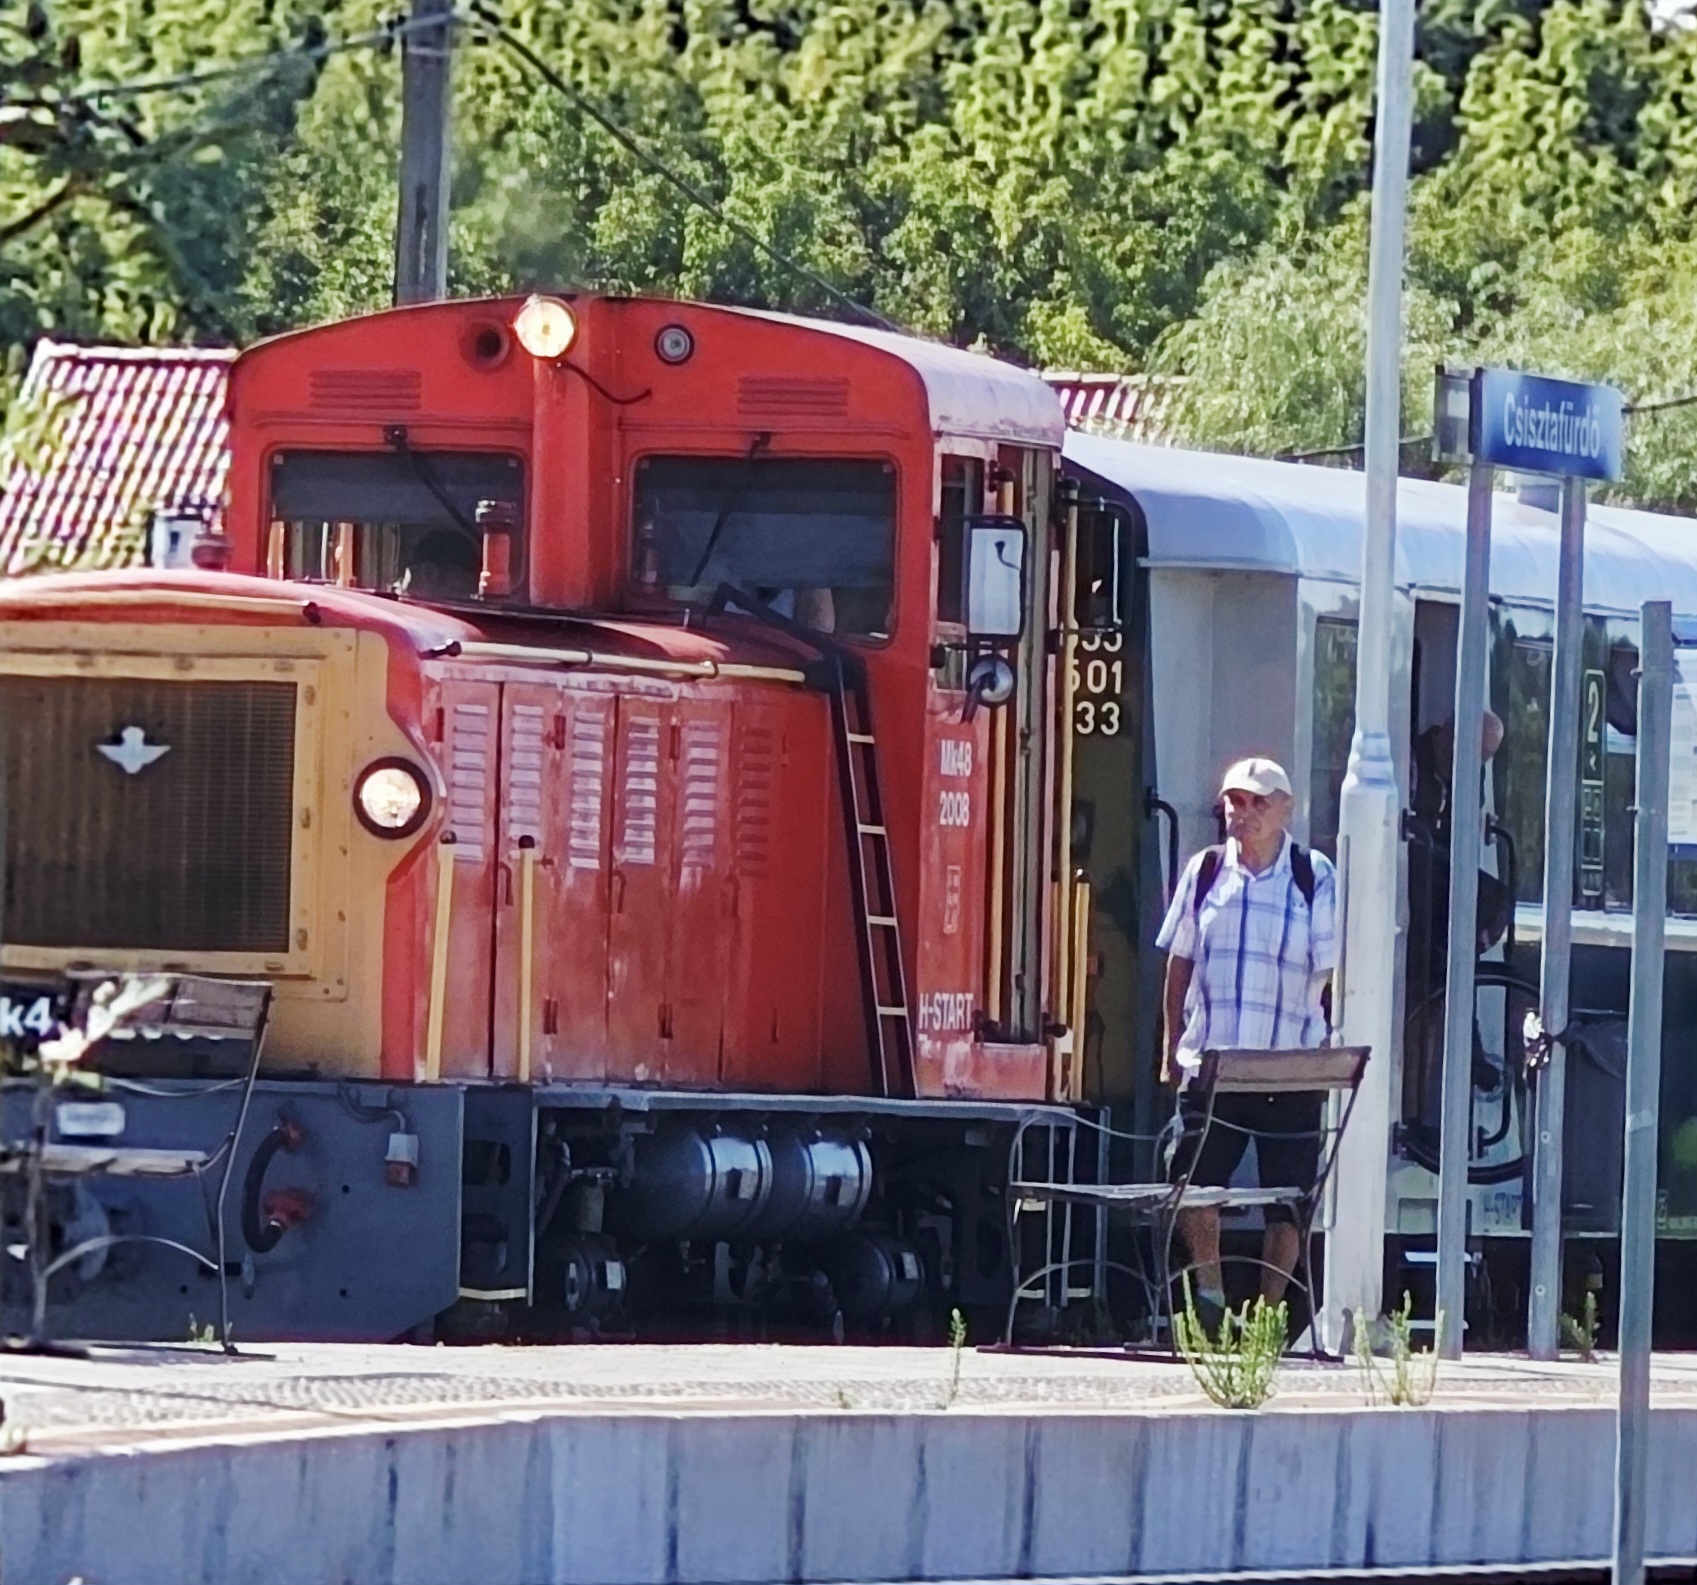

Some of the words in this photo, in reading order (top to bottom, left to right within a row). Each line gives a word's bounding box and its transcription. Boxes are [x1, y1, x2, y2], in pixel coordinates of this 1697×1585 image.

[1587, 680, 1600, 743] 2
[940, 738, 973, 777] Mk48
[939, 790, 970, 827] 2008
[0, 996, 54, 1038] k4
[919, 992, 974, 1031] H-START
